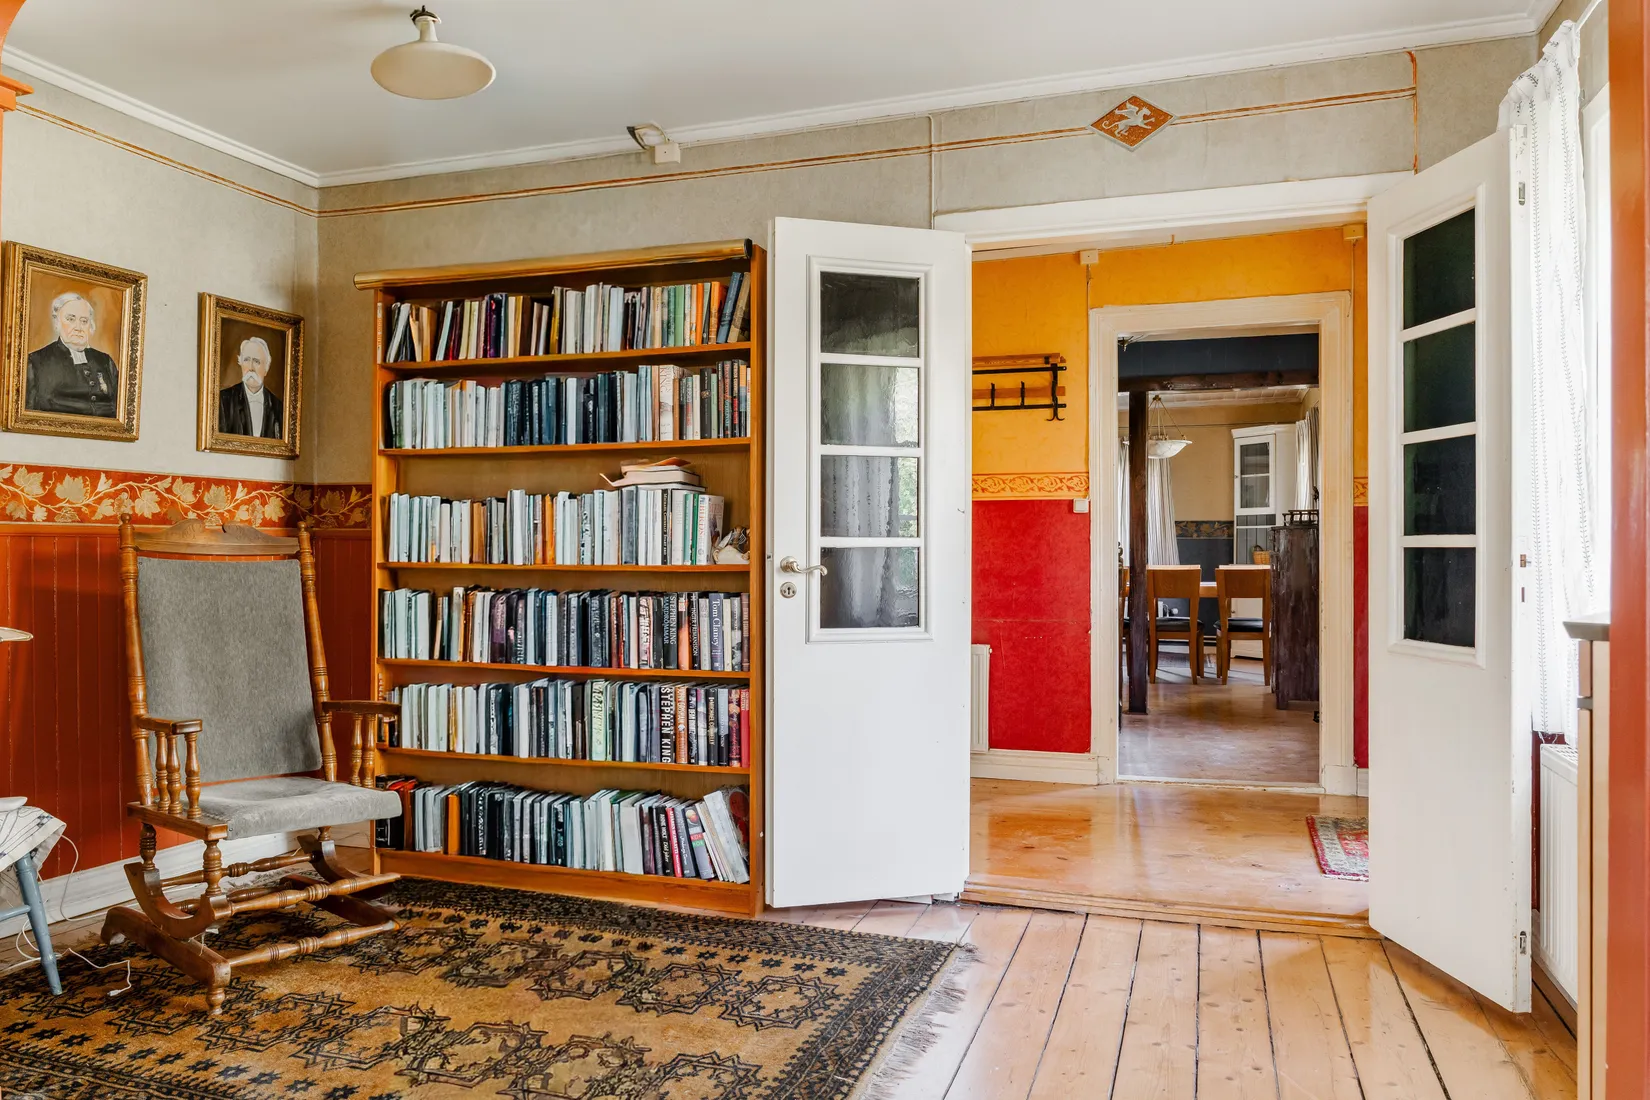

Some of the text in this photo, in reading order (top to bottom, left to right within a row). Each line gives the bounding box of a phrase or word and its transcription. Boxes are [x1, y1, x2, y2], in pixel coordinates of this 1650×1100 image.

[712, 598, 721, 617] Tom
[712, 618, 722, 647] Clancy
[660, 687, 671, 763] STEPHEN KING
